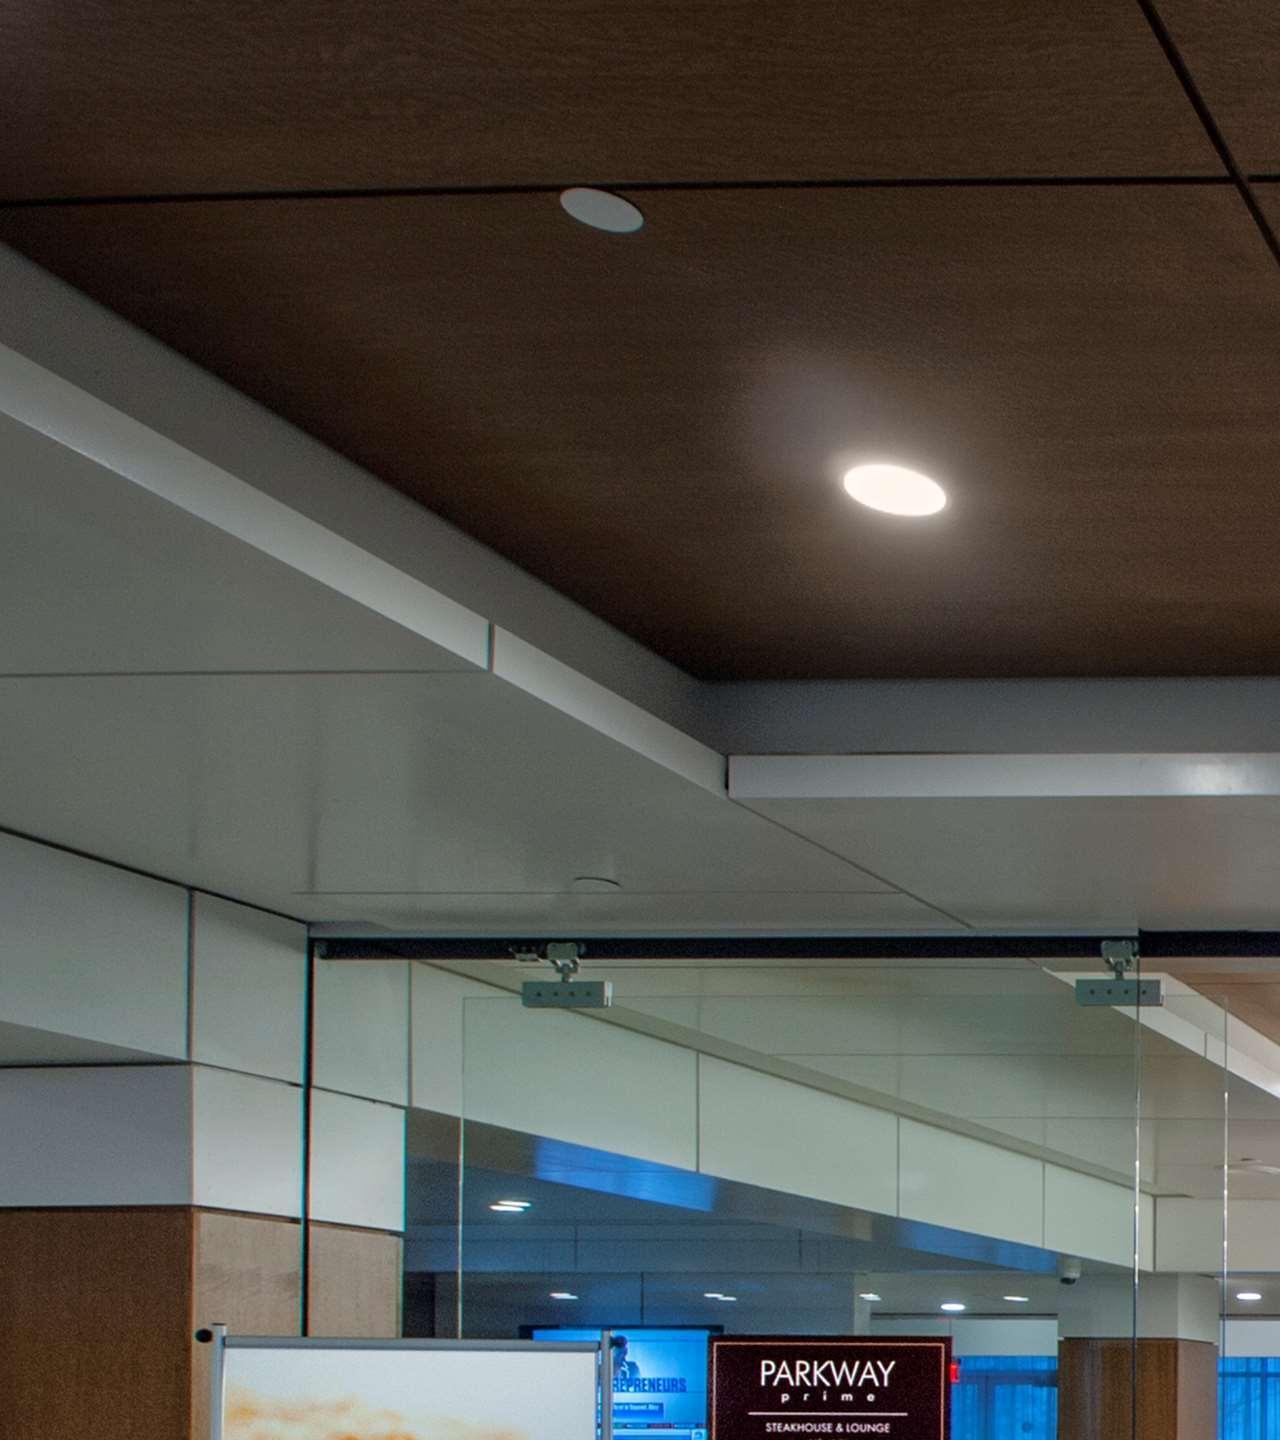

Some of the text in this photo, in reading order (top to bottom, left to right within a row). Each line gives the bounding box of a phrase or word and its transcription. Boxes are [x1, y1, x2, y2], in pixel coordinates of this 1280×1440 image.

[760, 1360, 896, 1387] PARKWAY
[781, 1391, 876, 1404] prime
[765, 1422, 891, 1434] STEAKHOUSE & LOUNGE
